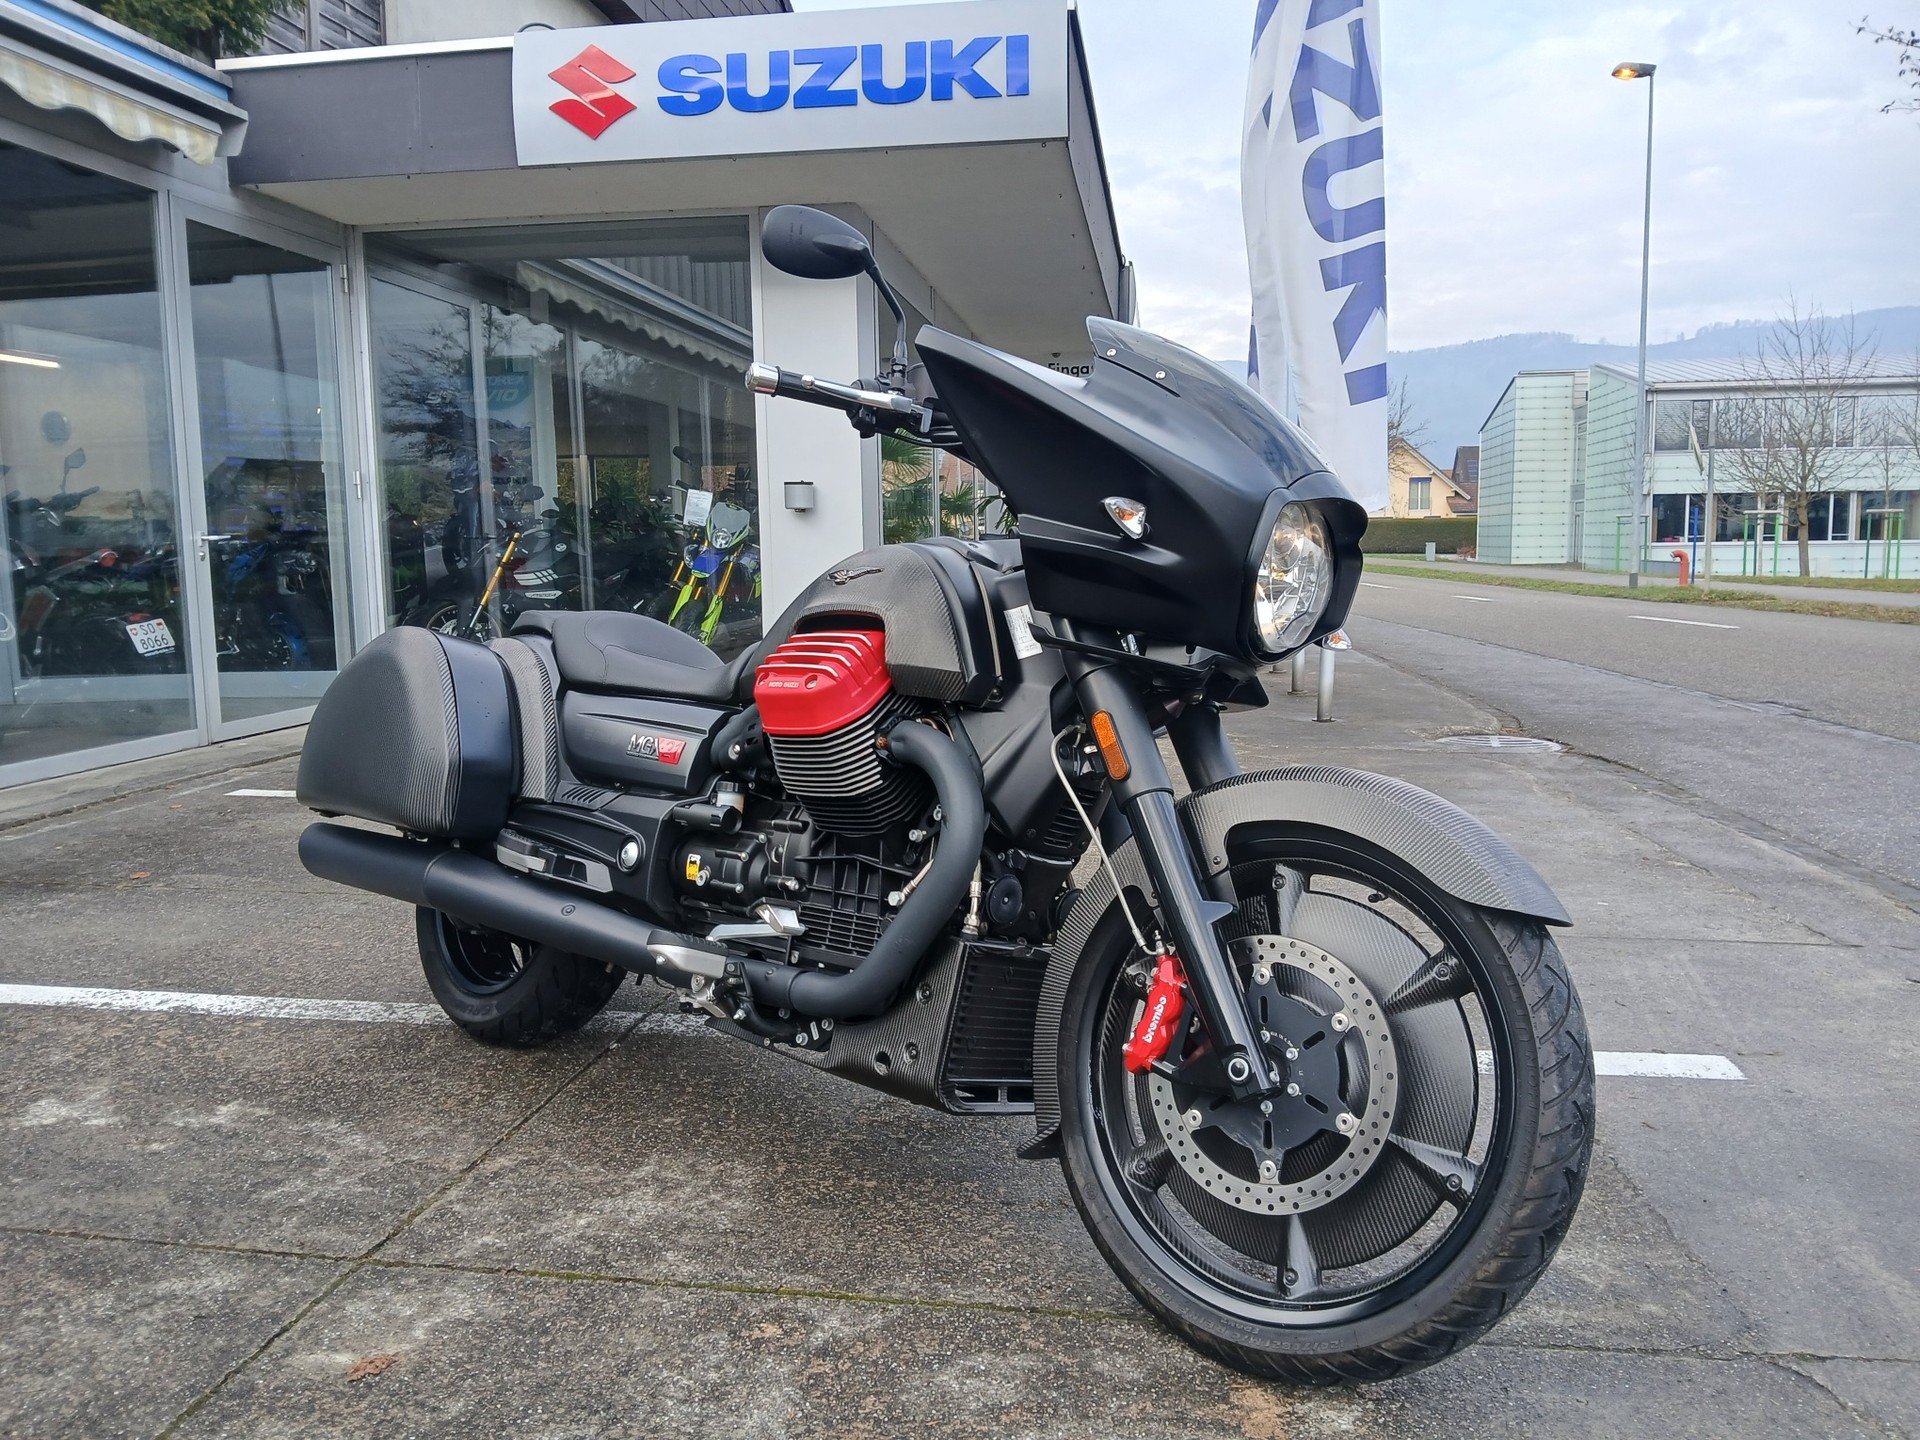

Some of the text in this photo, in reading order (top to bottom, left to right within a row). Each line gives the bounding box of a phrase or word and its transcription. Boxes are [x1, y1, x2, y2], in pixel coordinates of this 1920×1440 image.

[657, 34, 1030, 116] SUZUKI
[139, 623, 156, 635] SO
[140, 634, 169, 650] 8066
[1142, 996, 1167, 1043] brembo
